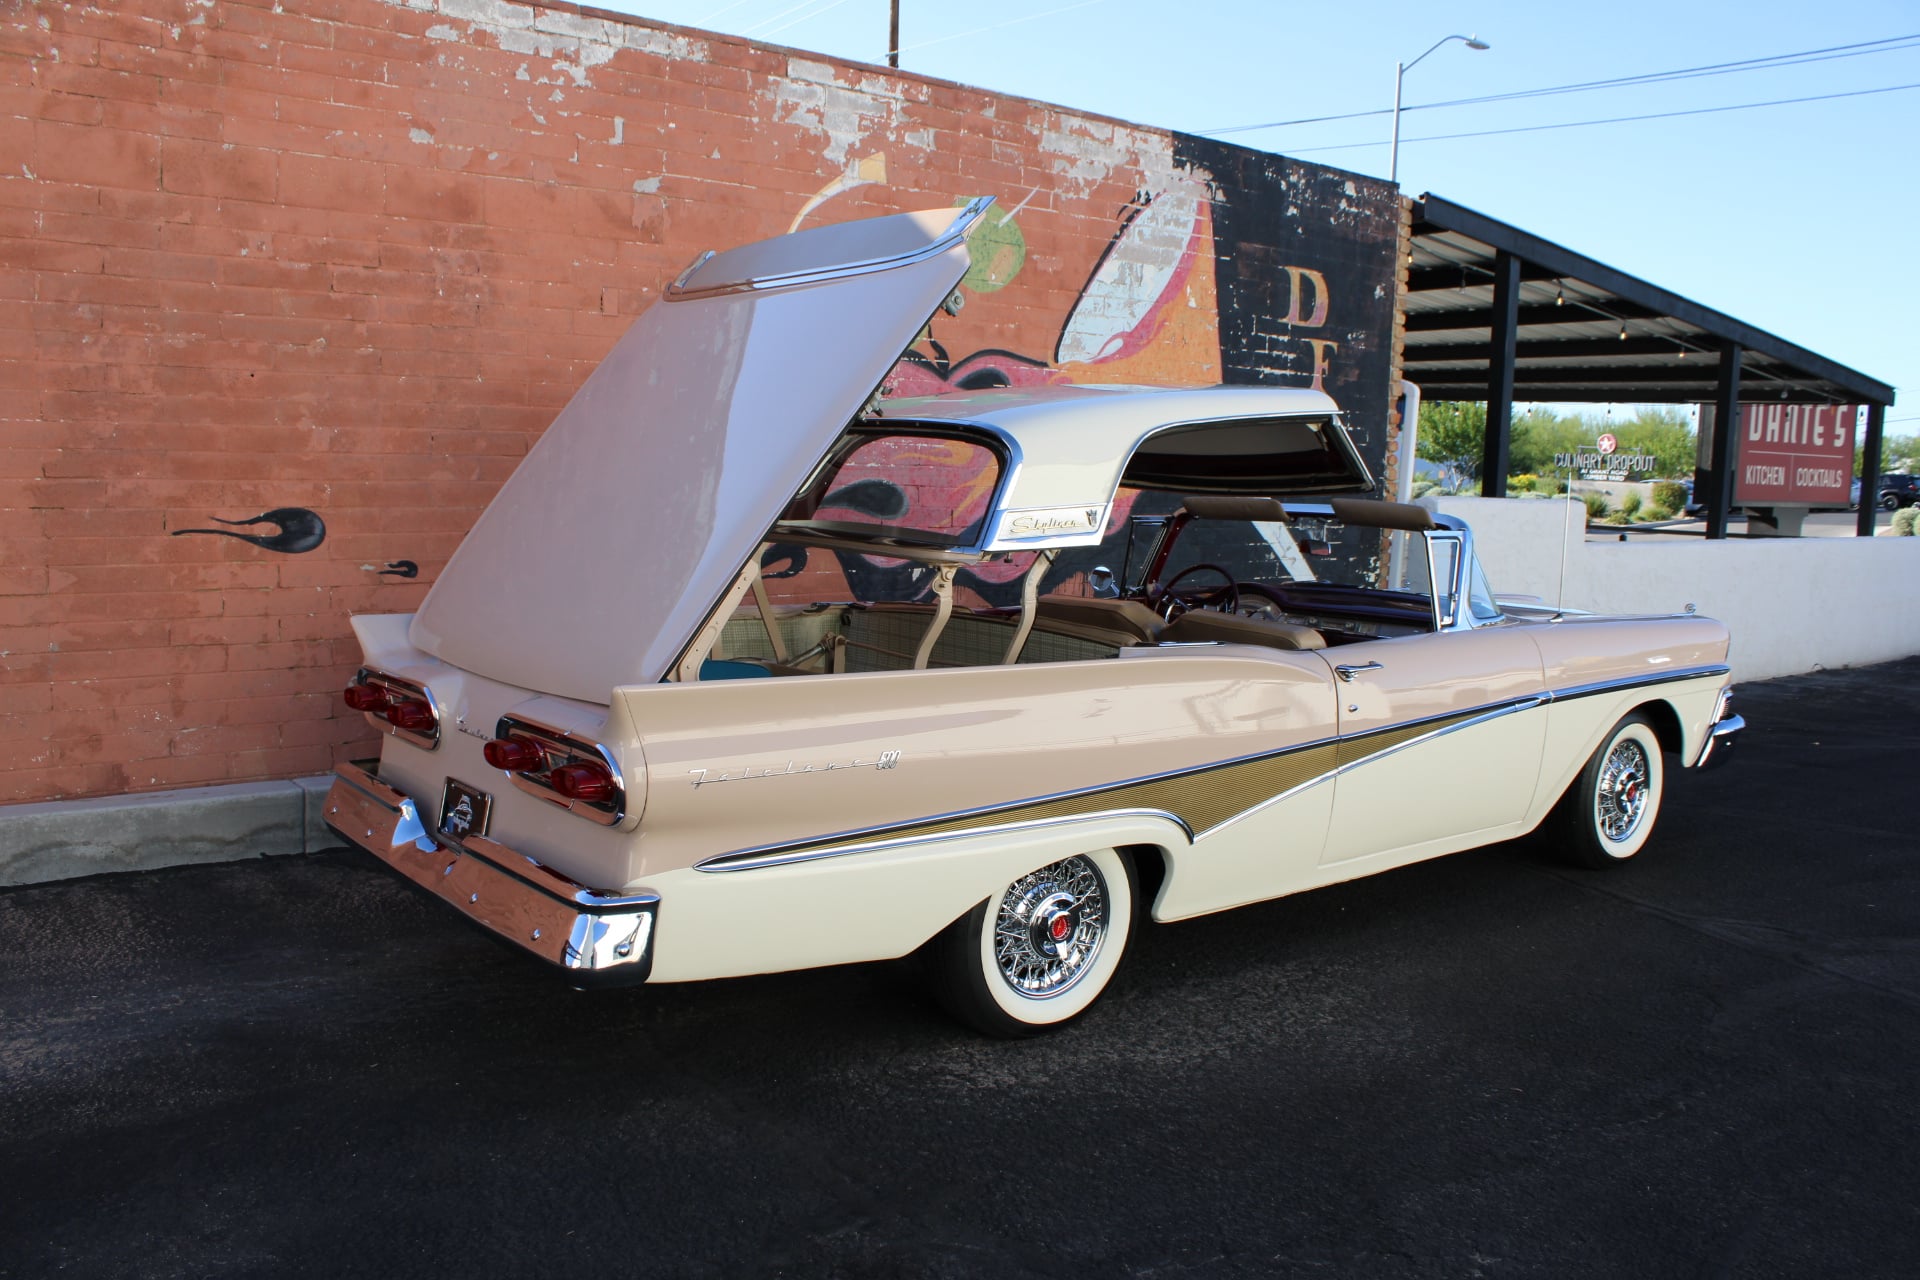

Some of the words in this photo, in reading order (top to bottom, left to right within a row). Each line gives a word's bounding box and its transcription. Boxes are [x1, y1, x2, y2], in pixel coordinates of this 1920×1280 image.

[1277, 265, 1329, 328] D
[1554, 452, 1604, 470] CULINARY
[1606, 453, 1657, 472] DROPOUT
[1745, 465, 1786, 486] KITCHEN
[1796, 467, 1843, 488] COCKTAILS
